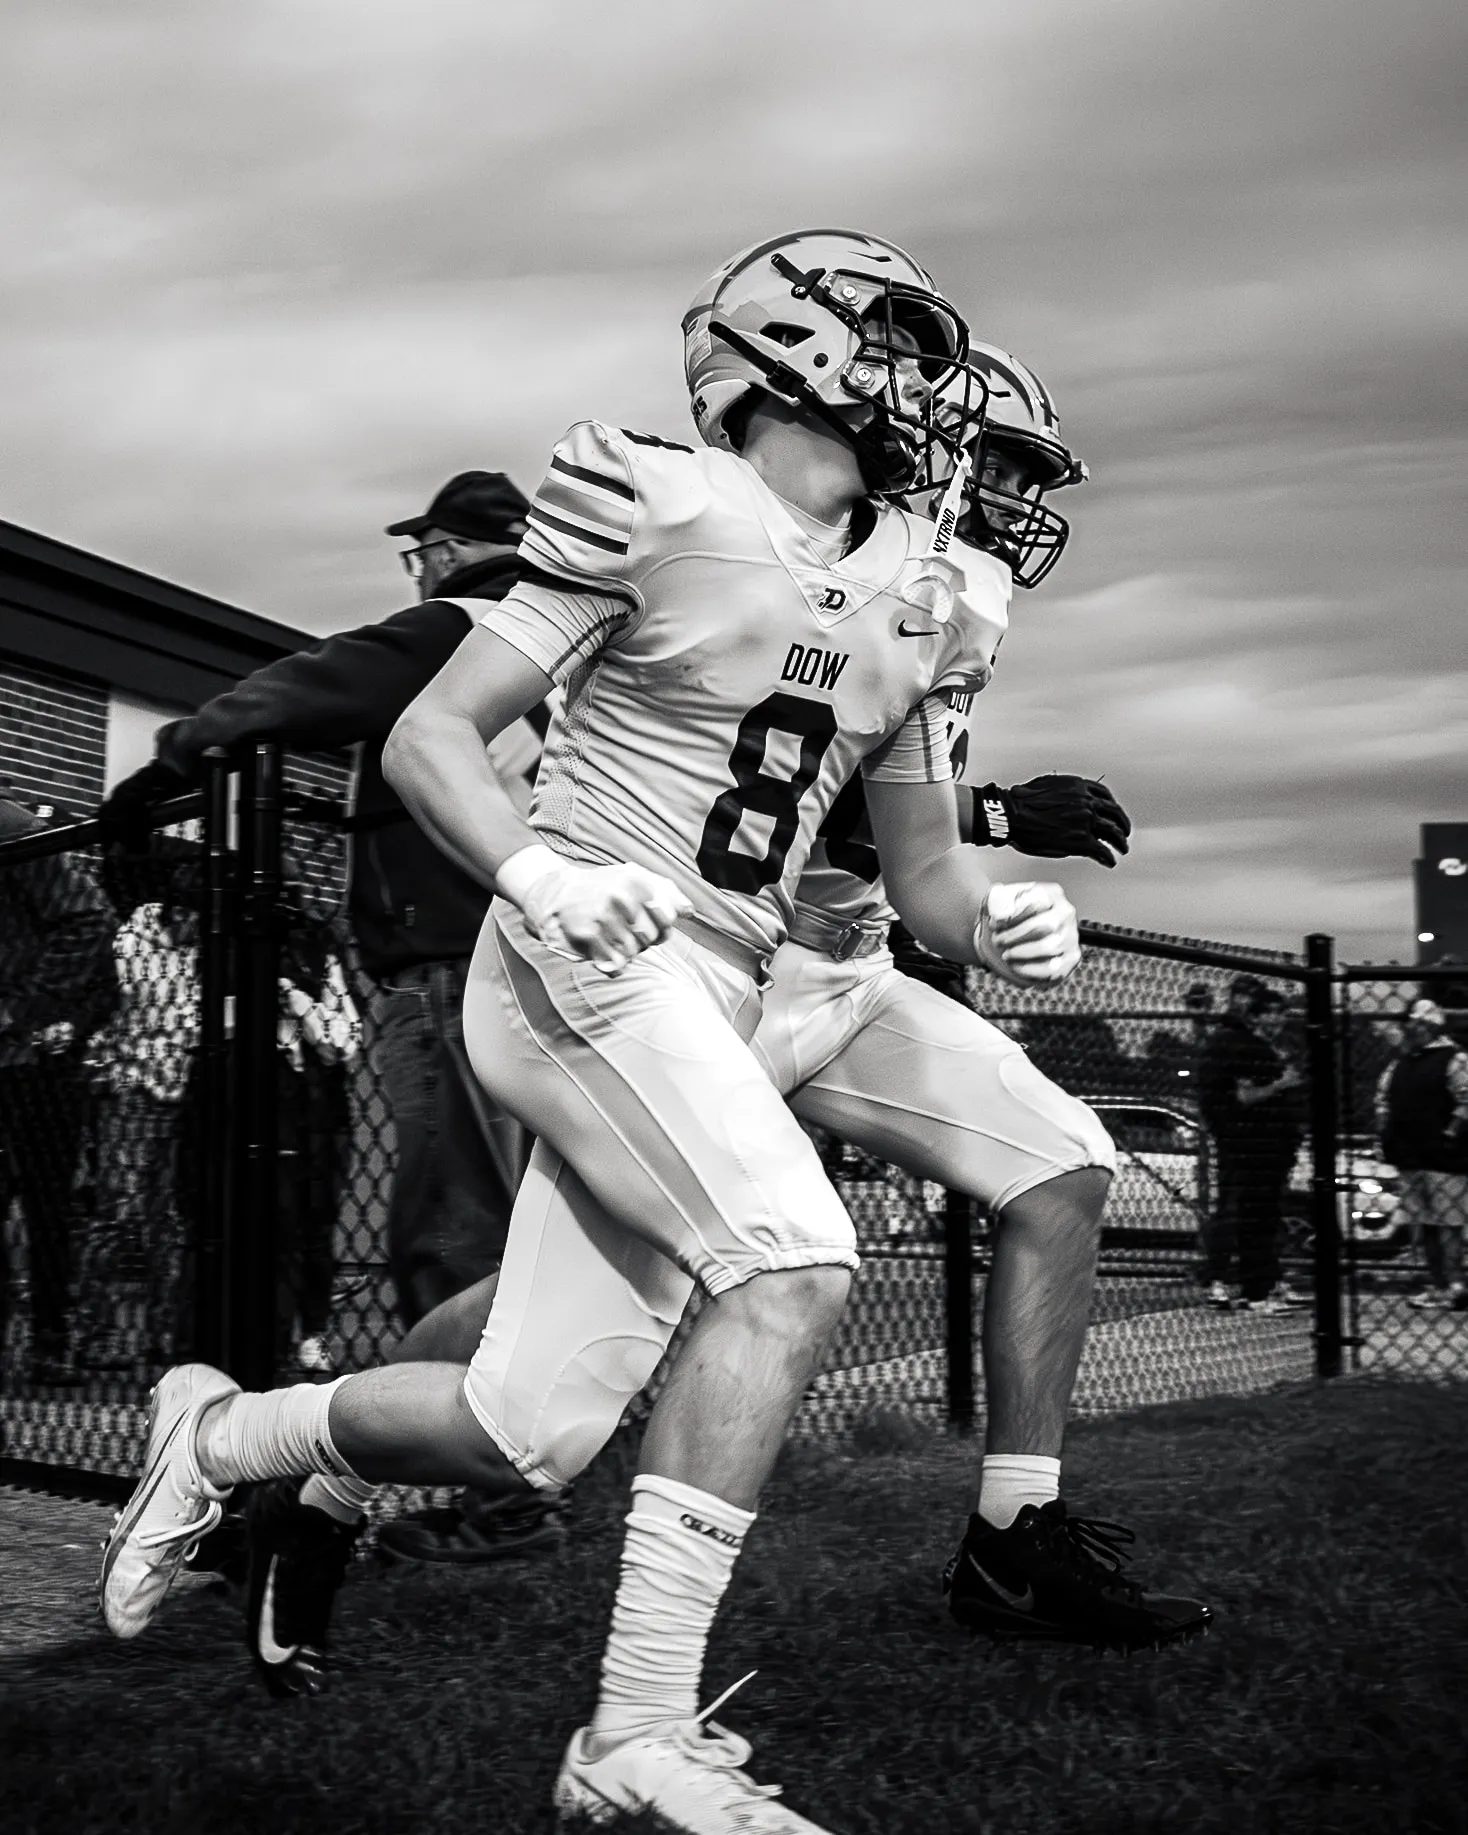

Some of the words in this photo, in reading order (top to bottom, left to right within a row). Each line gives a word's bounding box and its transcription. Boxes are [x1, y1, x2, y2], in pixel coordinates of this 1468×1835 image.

[781, 643, 849, 691] DOW
[695, 691, 839, 896] 8
[983, 798, 1010, 839] NIKE
